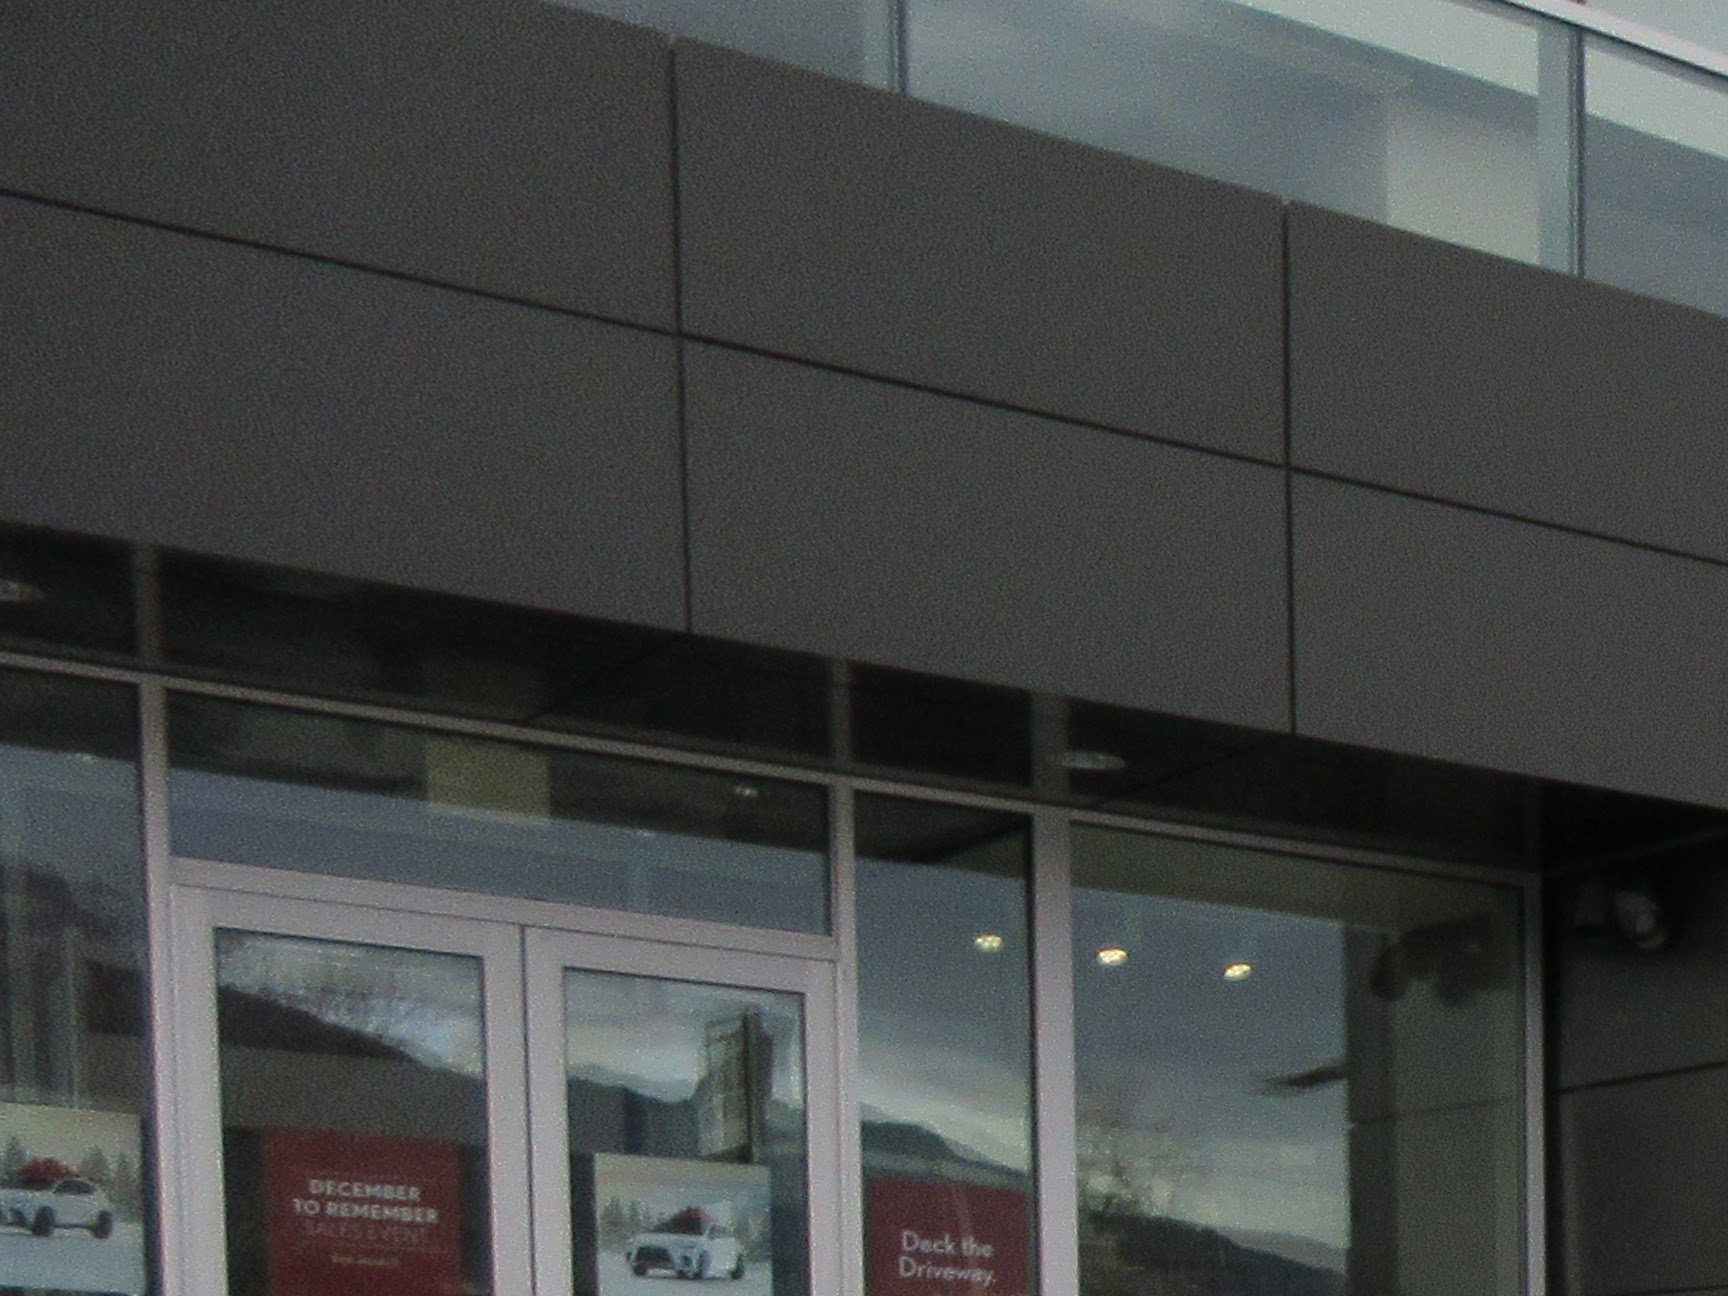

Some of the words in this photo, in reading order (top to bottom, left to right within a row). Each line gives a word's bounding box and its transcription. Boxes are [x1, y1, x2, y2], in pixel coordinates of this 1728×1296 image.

[308, 1179, 421, 1201] DECEMBER
[293, 1198, 321, 1216] TO
[325, 1201, 438, 1224] REMEMBER
[902, 1229, 956, 1253] Deck
[961, 1234, 994, 1258] the
